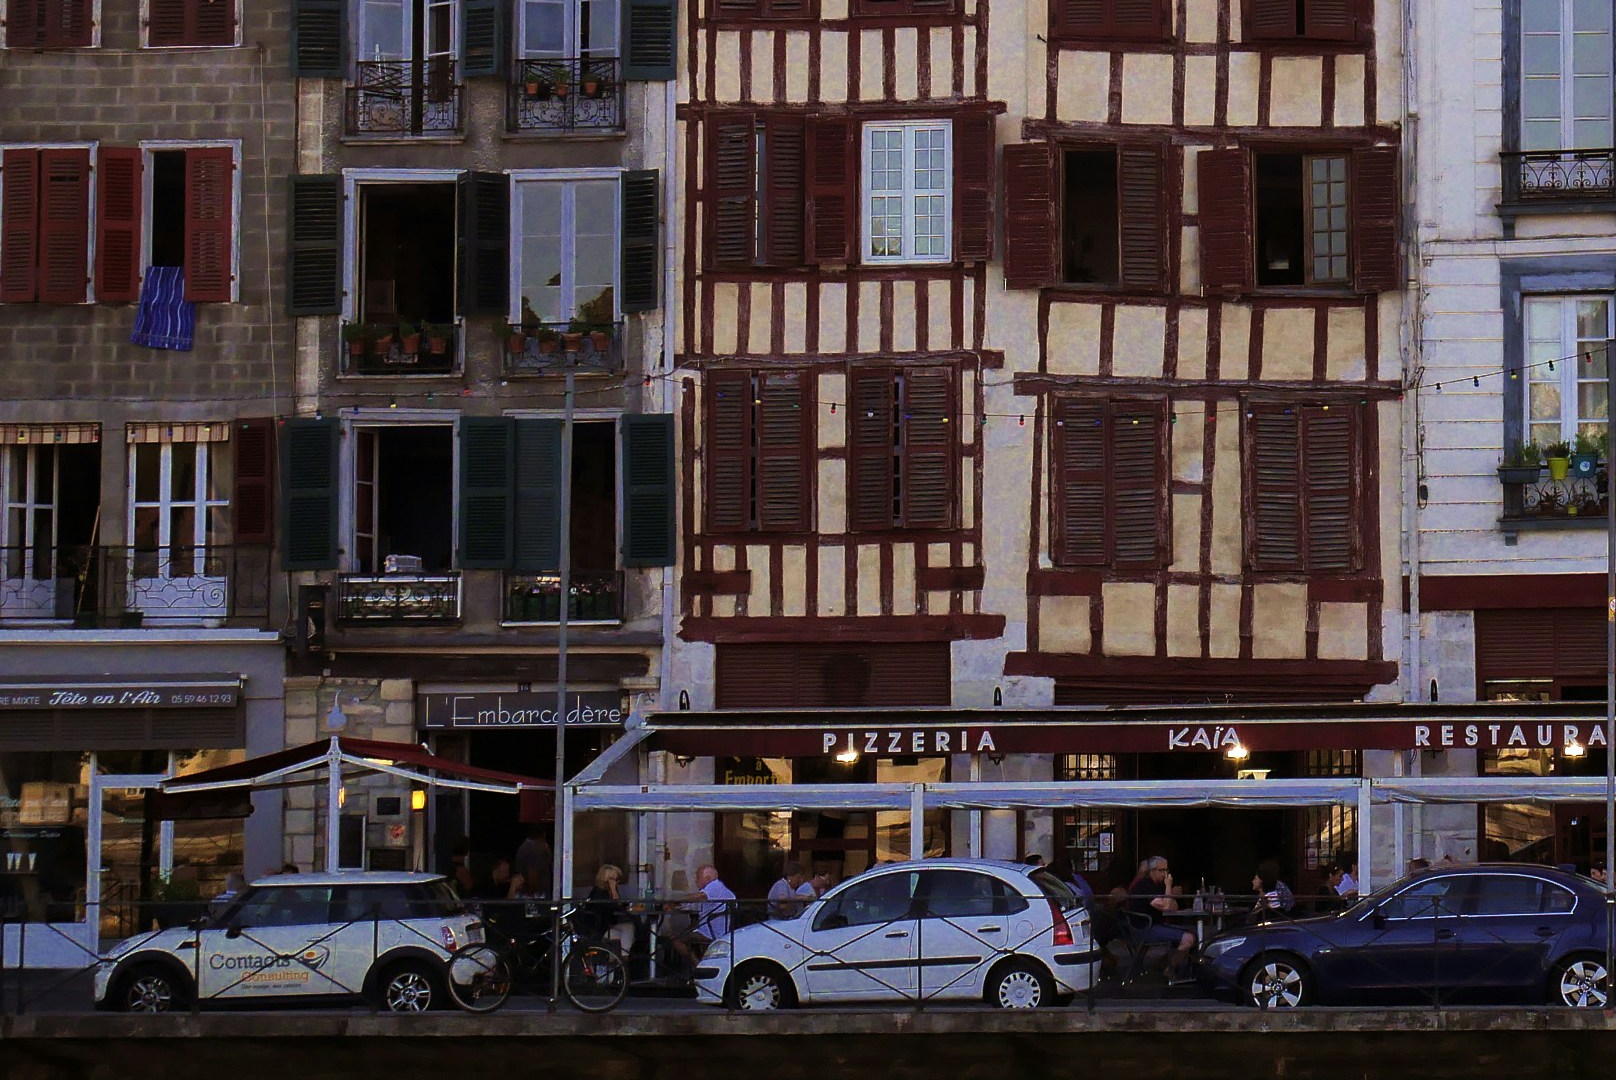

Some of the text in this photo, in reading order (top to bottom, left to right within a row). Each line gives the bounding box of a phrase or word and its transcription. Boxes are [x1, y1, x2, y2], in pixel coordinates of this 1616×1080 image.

[12, 696, 40, 705] MIXTE
[49, 691, 88, 705] Tête
[92, 694, 115, 705] en
[119, 690, 161, 705] l'Air
[823, 730, 996, 753] PIZZERIA
[1169, 726, 1241, 751] KAÏA
